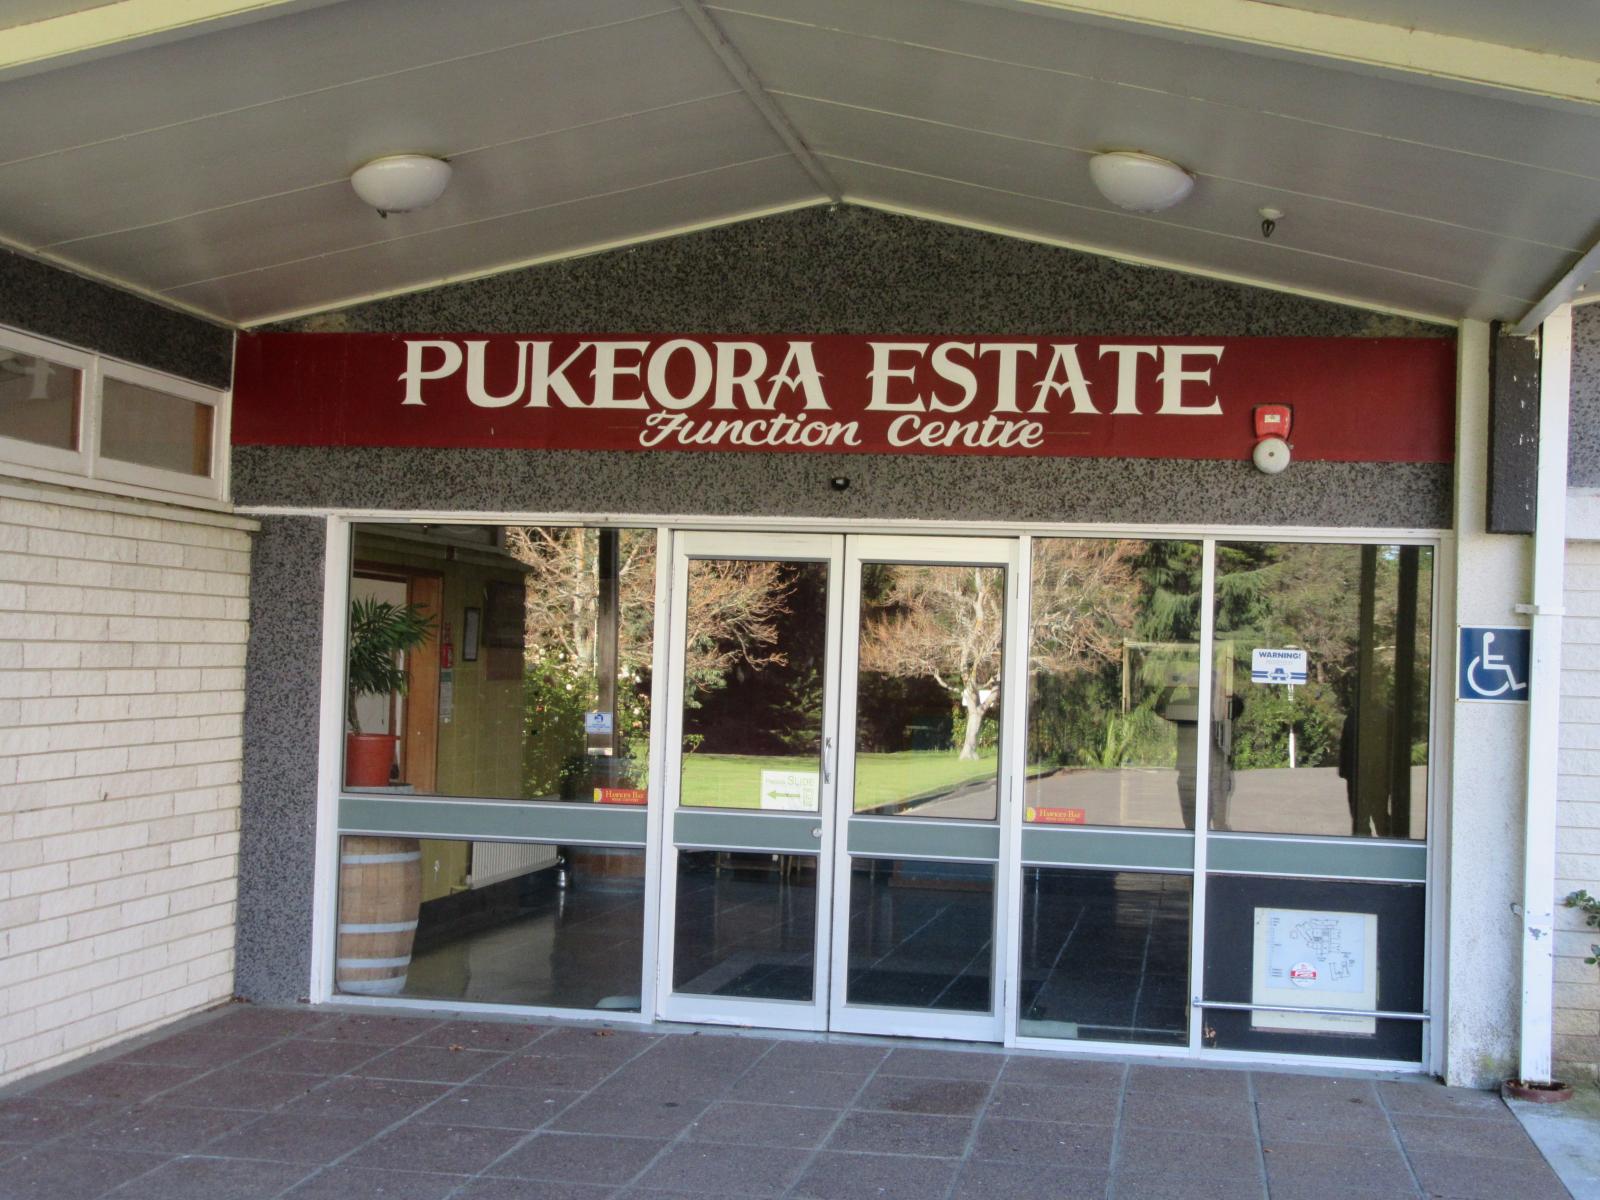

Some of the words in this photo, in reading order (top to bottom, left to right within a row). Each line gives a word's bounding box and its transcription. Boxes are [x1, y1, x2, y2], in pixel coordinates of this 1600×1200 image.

[398, 338, 831, 411] PUKEORA
[864, 341, 1225, 416] ESTATE
[639, 410, 861, 447] Function
[887, 414, 1044, 449] Centre
